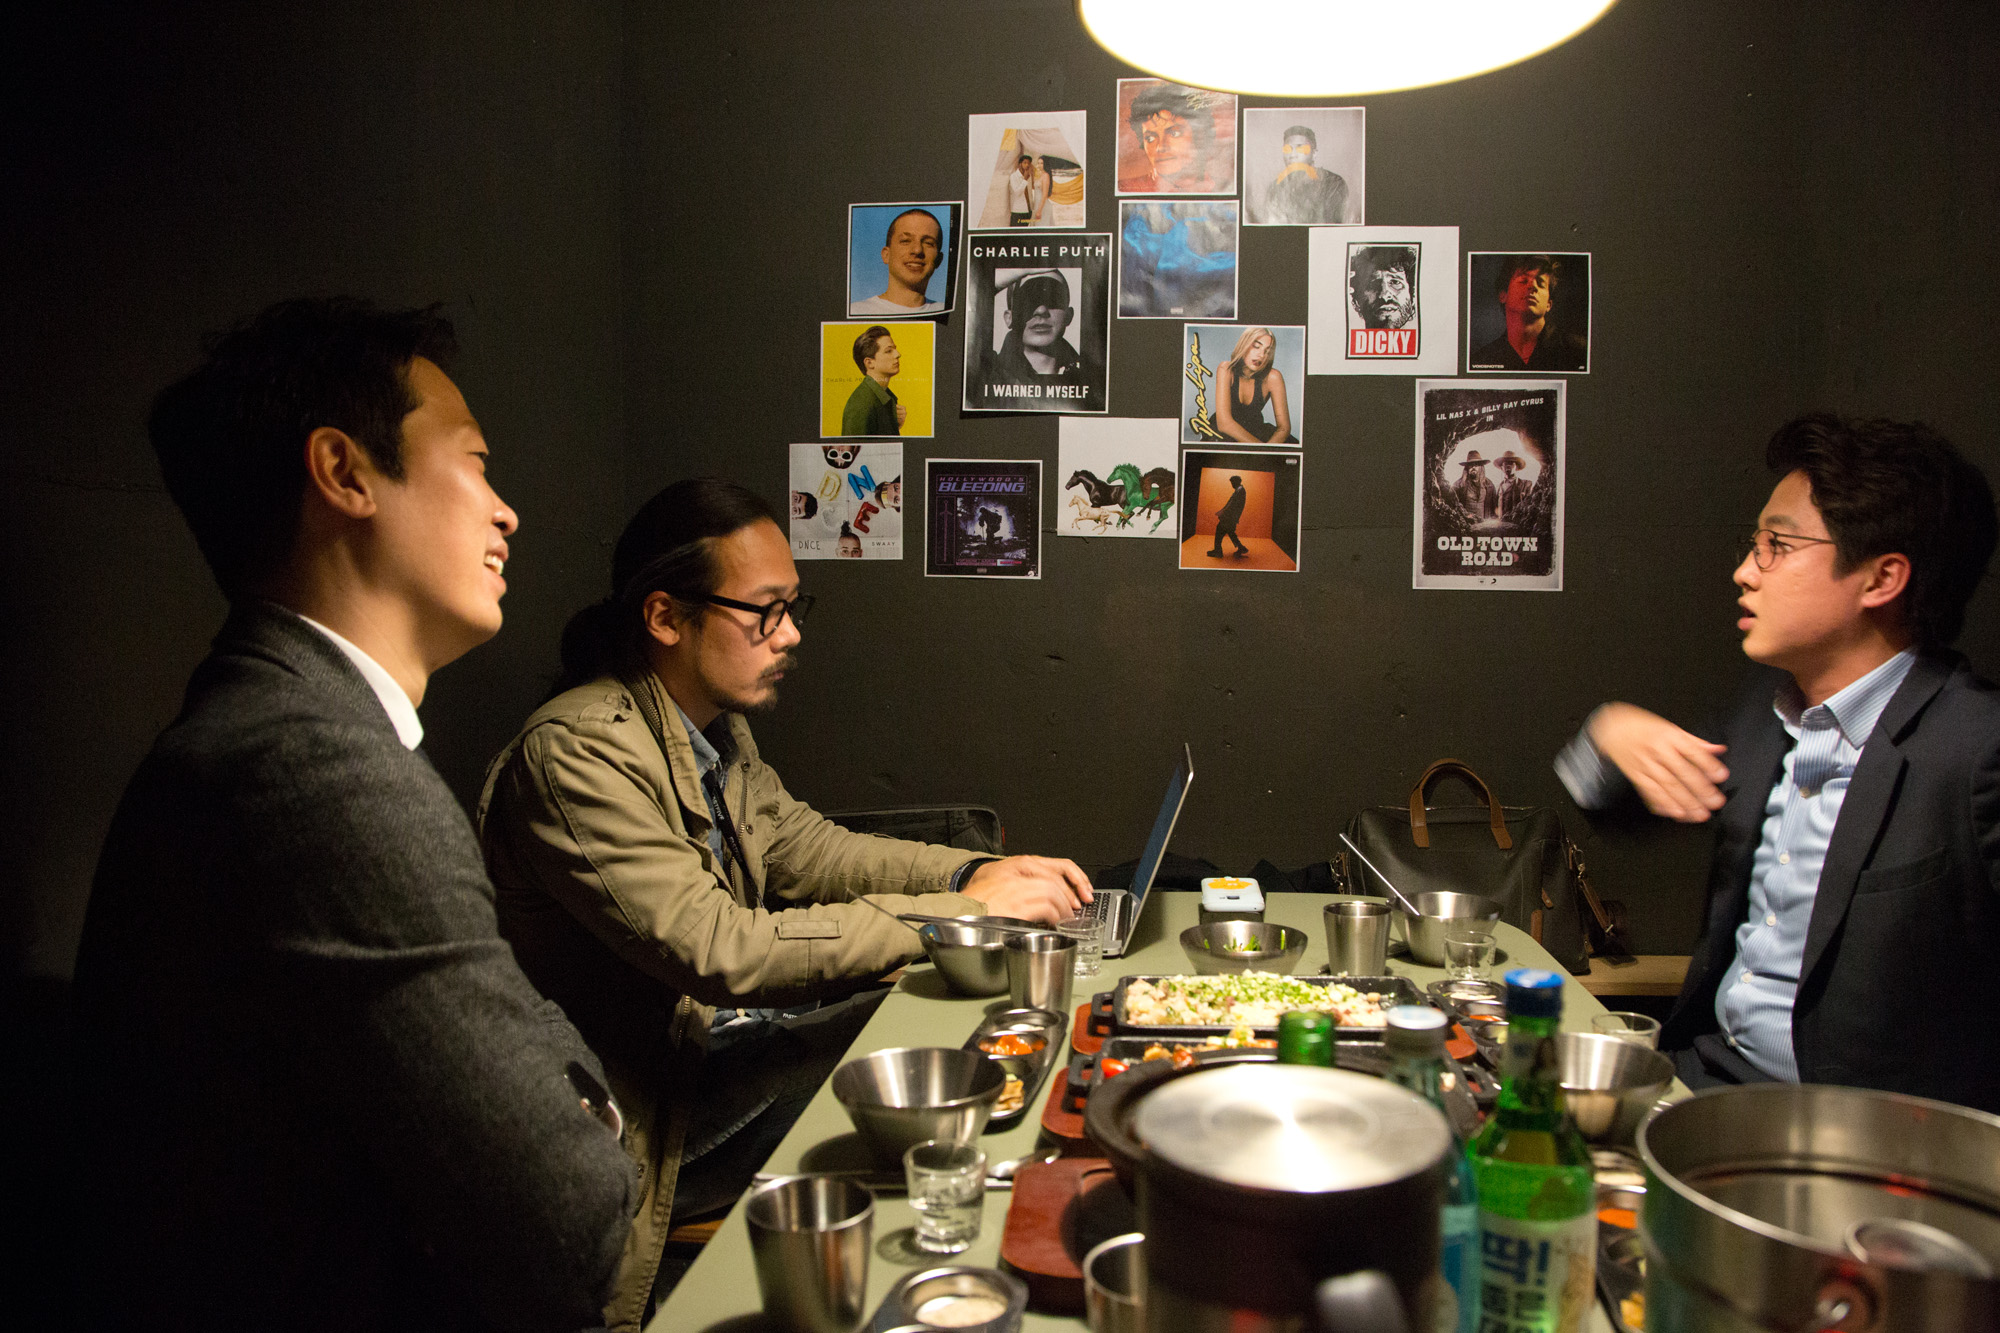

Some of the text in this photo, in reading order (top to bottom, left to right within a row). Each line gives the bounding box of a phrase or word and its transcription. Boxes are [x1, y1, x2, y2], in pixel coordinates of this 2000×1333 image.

[973, 246, 1104, 257] CHARLIE PUTH
[1355, 330, 1411, 354] DICKY
[984, 384, 1089, 399] I WARNED MYSELF
[1436, 413, 1447, 421] LIL
[1449, 411, 1464, 419] NAS
[1481, 404, 1501, 414] BILLY
[1503, 401, 1518, 410] RAY
[1520, 397, 1544, 407] CYRUS
[938, 482, 1026, 493] BLEEDING
[798, 540, 820, 551] DNCE
[1437, 536, 1538, 552] OLD TOWN
[1461, 551, 1513, 566] ROAD
